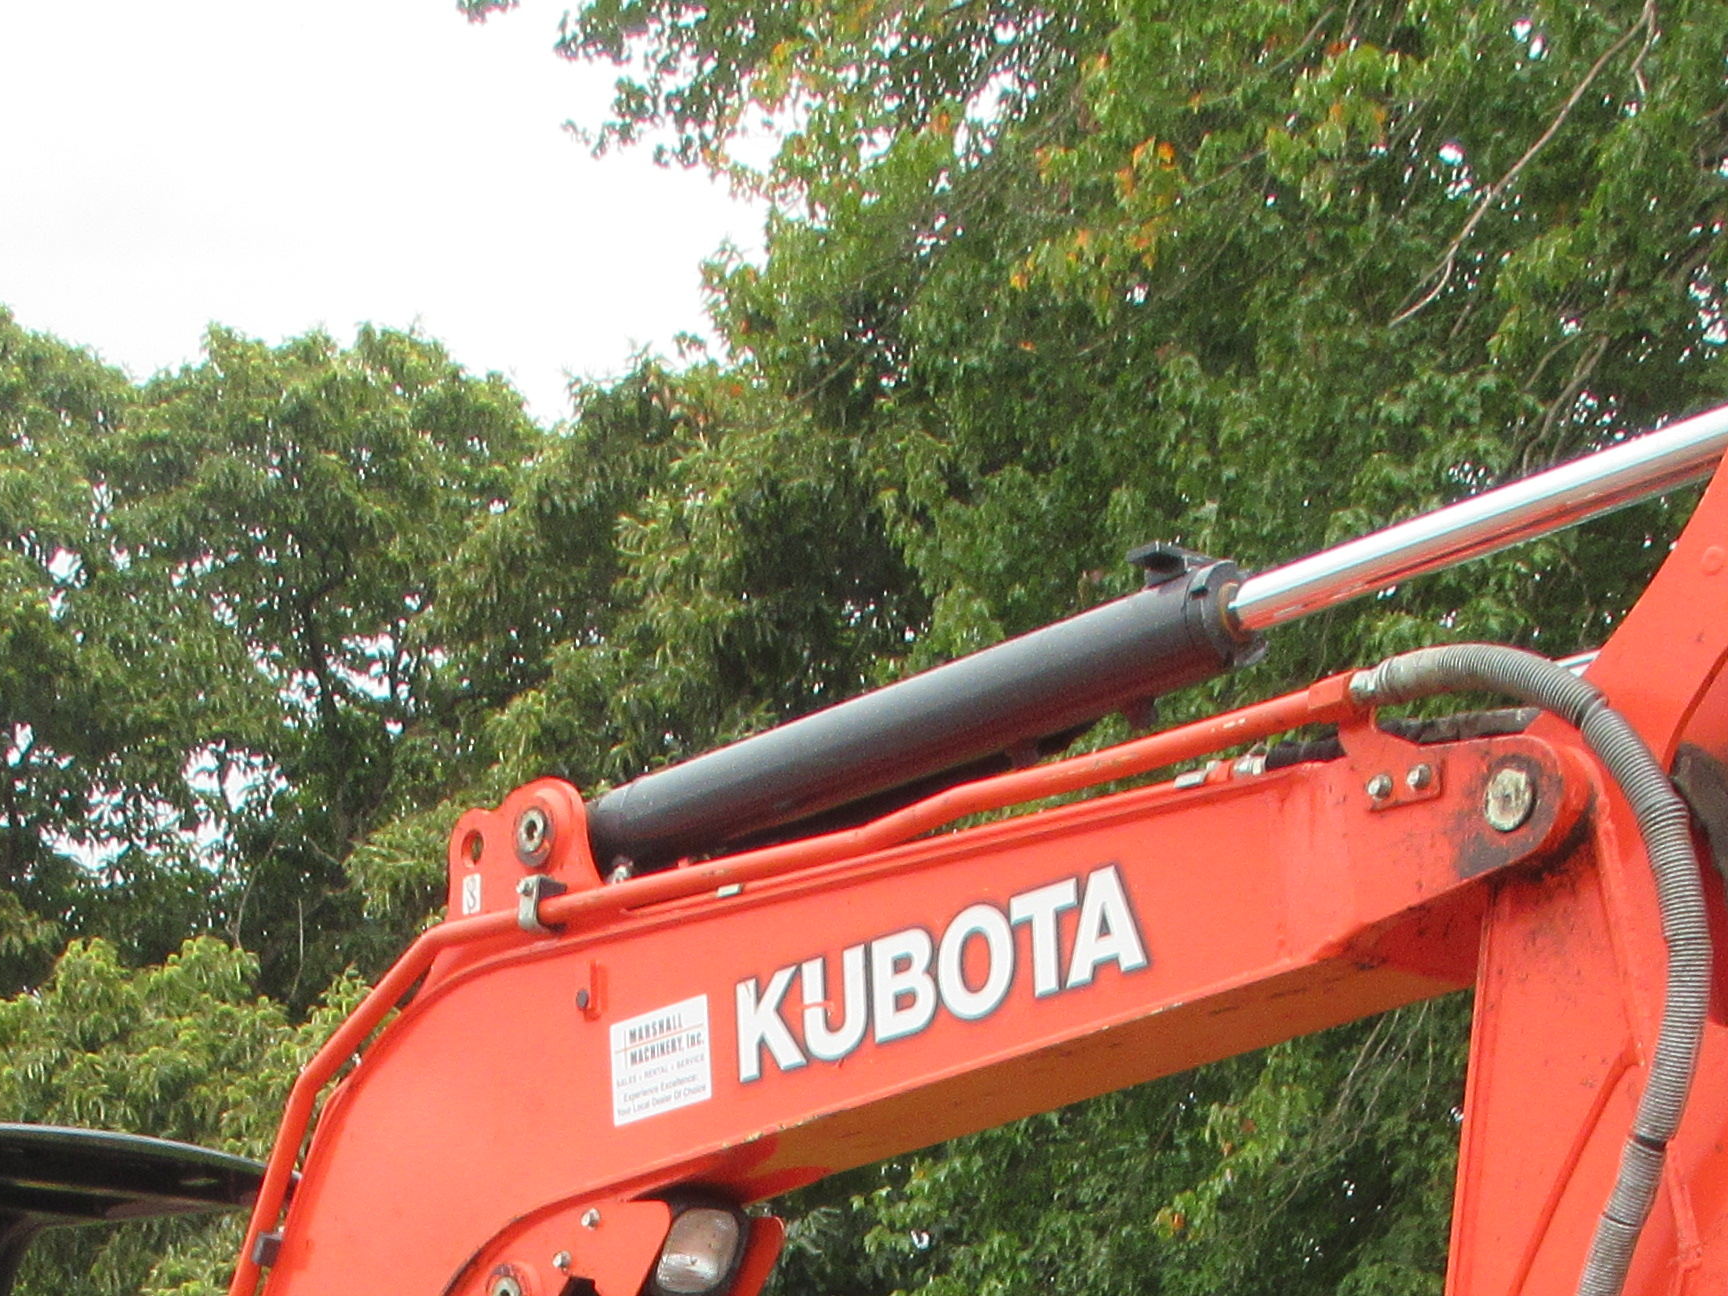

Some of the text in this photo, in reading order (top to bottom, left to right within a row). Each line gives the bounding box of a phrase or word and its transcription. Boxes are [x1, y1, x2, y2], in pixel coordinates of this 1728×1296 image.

[734, 864, 1148, 1084] KUBOTA
[629, 1013, 683, 1044] MARSHALL
[686, 1031, 705, 1049] Inc.
